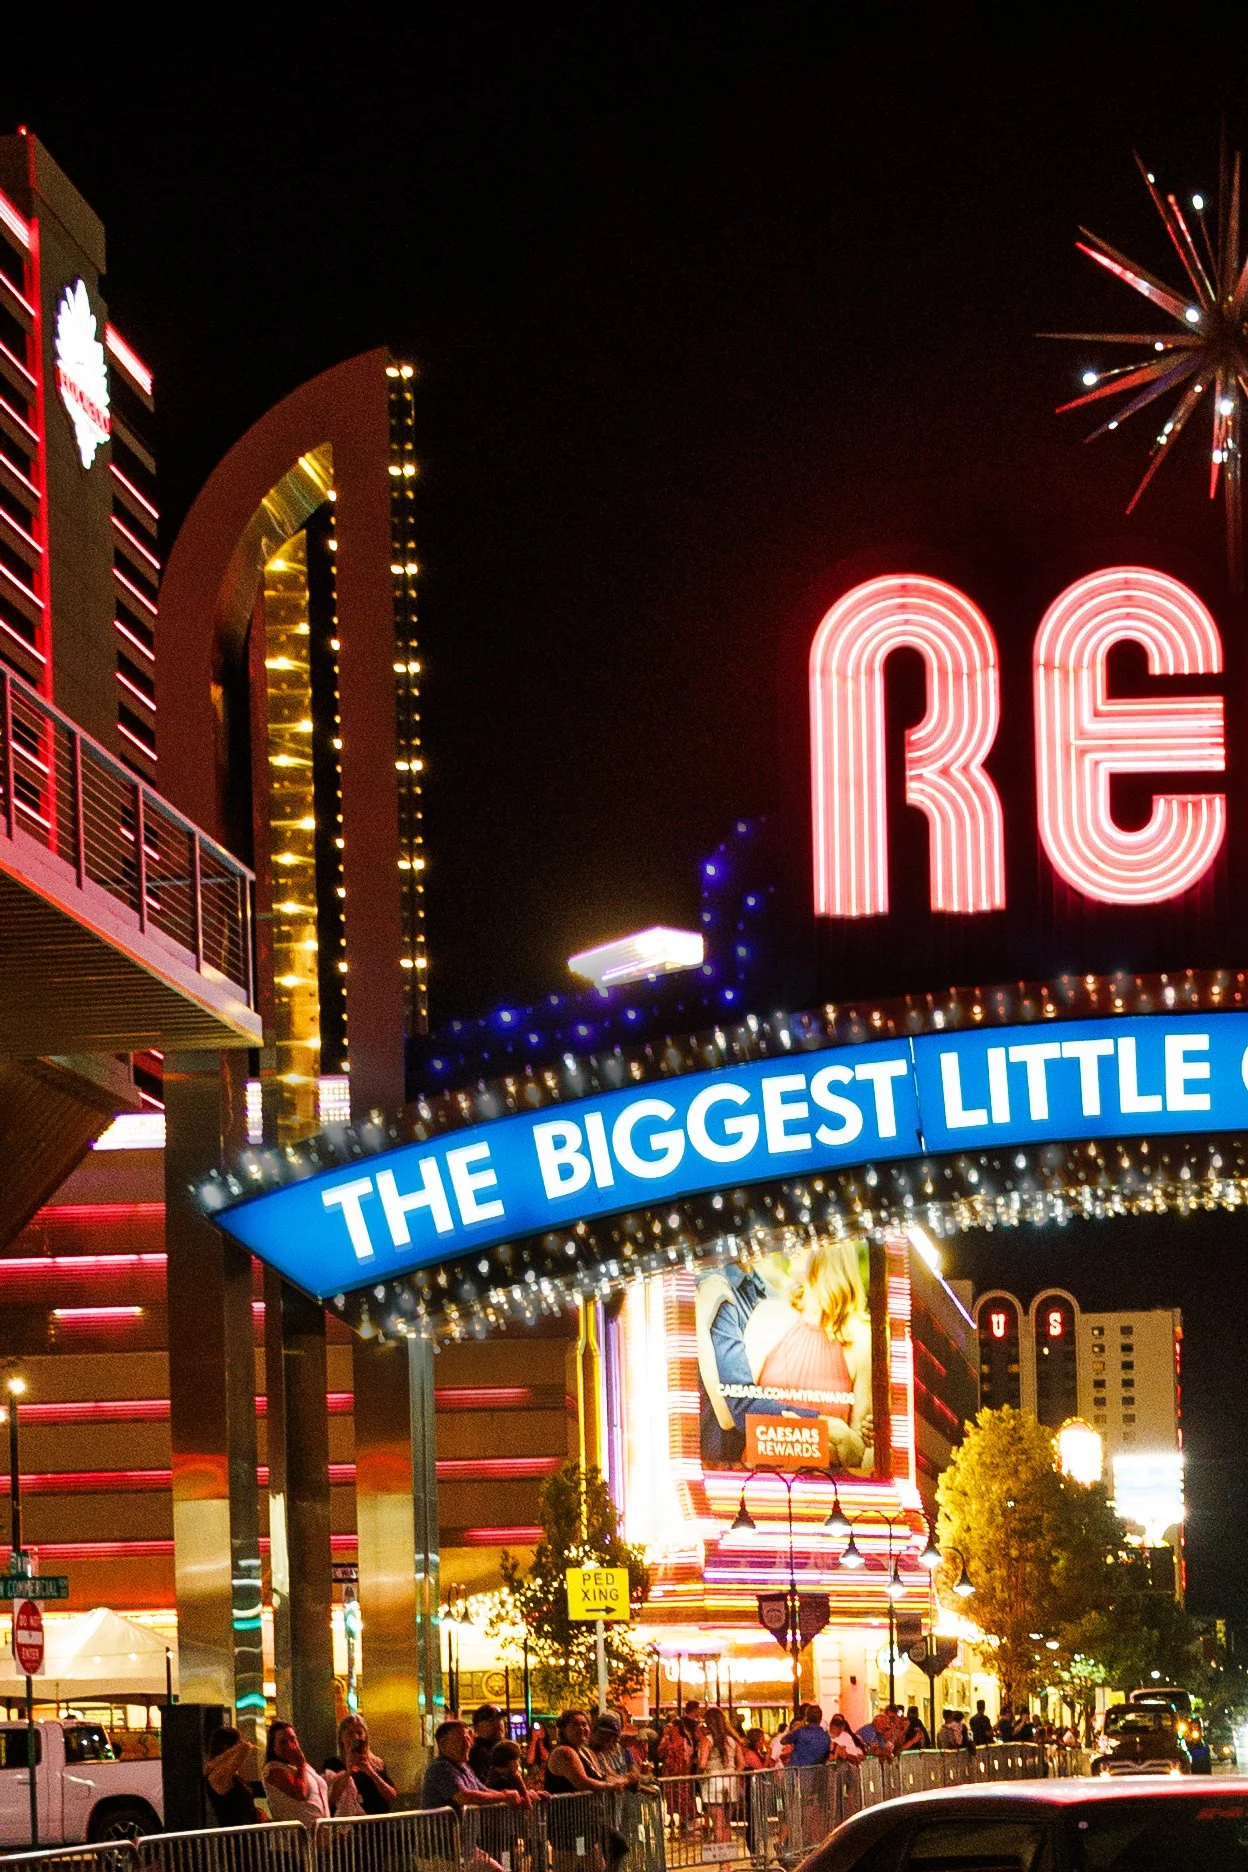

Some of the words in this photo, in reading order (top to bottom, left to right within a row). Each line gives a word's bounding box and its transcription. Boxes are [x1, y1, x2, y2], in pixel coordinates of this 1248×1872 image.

[322, 1144, 504, 1260] THE
[533, 1061, 907, 1199] BIGGEST
[940, 1034, 1211, 1129] LITTLE
[716, 1383, 856, 1404] CAESARS.COM/MYREWARDS
[756, 1425, 819, 1443] CAESARS
[757, 1441, 821, 1458] REWARDS
[582, 1572, 615, 1586] PED
[581, 1588, 619, 1601] XING
